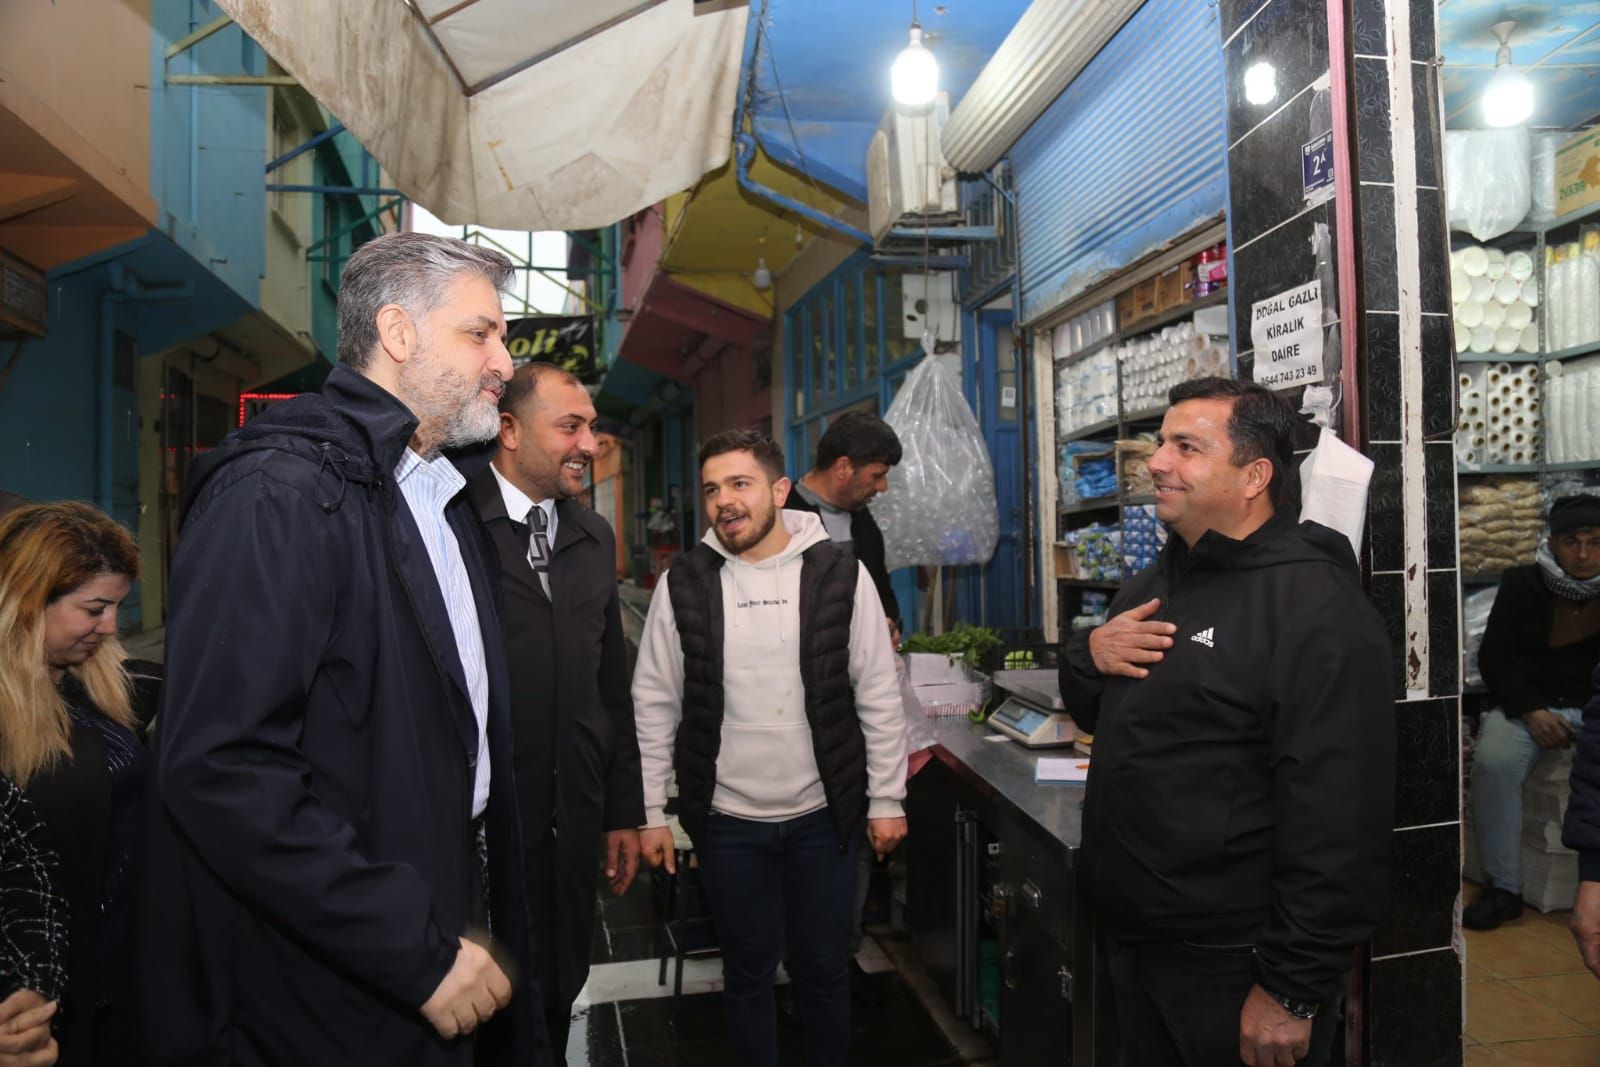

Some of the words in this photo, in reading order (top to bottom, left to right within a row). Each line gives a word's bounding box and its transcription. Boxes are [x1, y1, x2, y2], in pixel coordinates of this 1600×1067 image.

[1266, 317, 1304, 340] KİRALIK
[1271, 343, 1300, 362] DAİRE
[1280, 370, 1294, 383] 743
[1295, 368, 1305, 379] 23
[1307, 365, 1317, 376] 49
[1191, 635, 1214, 648] adidas
